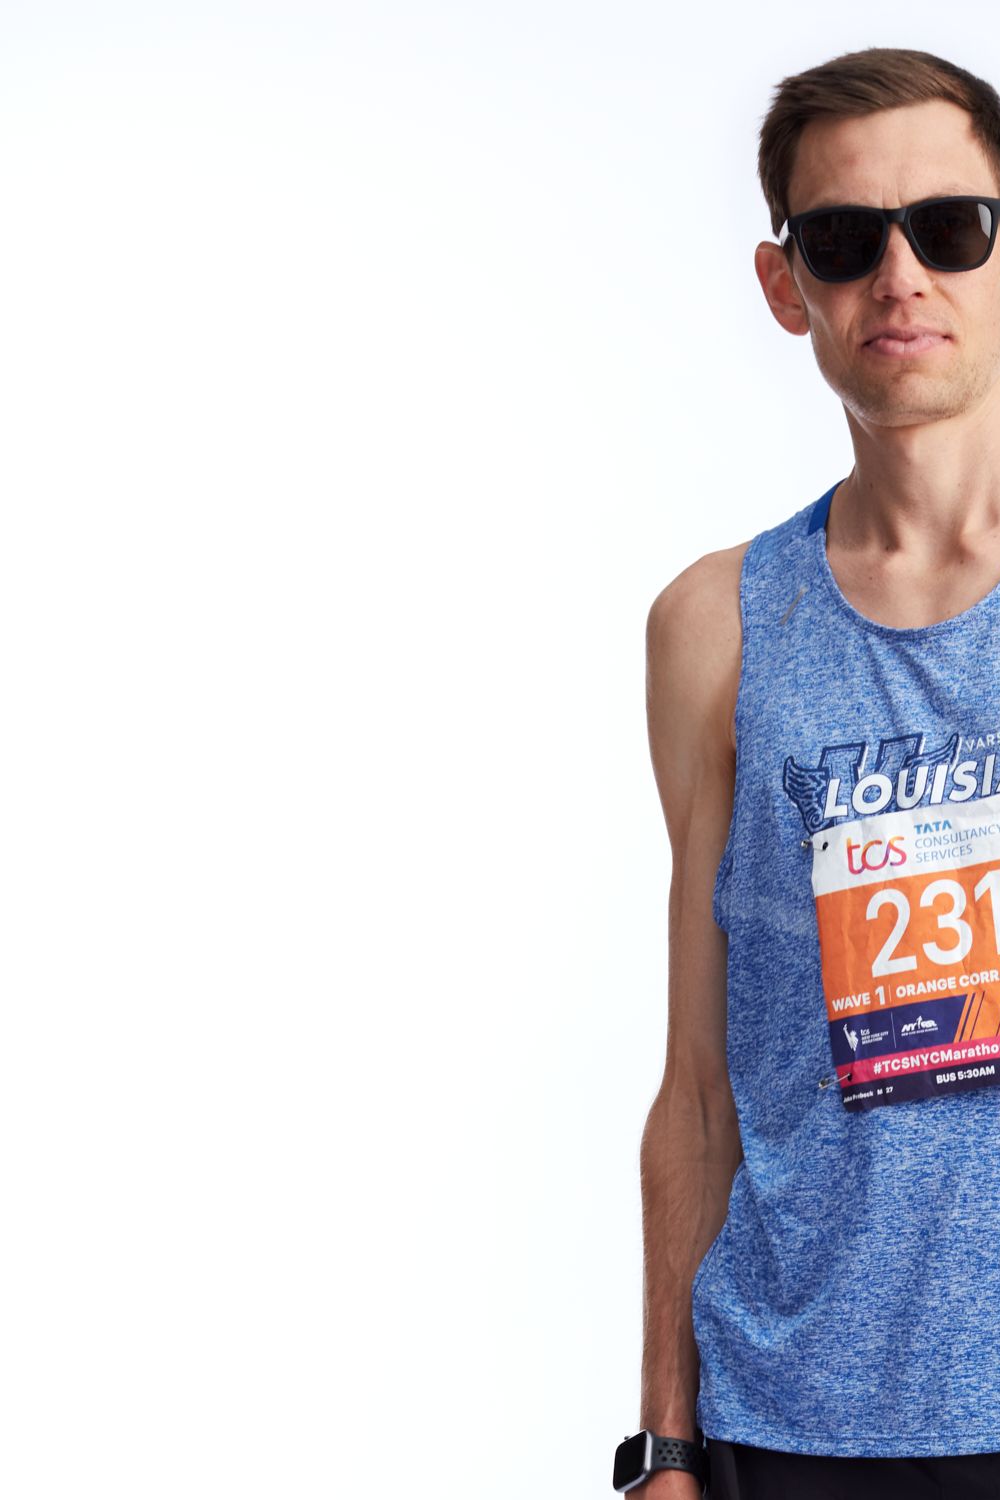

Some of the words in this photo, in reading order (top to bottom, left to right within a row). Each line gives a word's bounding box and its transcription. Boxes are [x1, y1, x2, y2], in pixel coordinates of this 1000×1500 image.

[914, 819, 953, 835] TATA
[846, 835, 907, 875] tcs
[915, 844, 973, 863] SERVICES
[832, 992, 871, 1012] WAVE
[874, 985, 886, 1006] 1
[895, 976, 956, 998] ORANGE
[936, 1072, 956, 1084] BUS
[957, 1065, 995, 1081] 5:30AM
